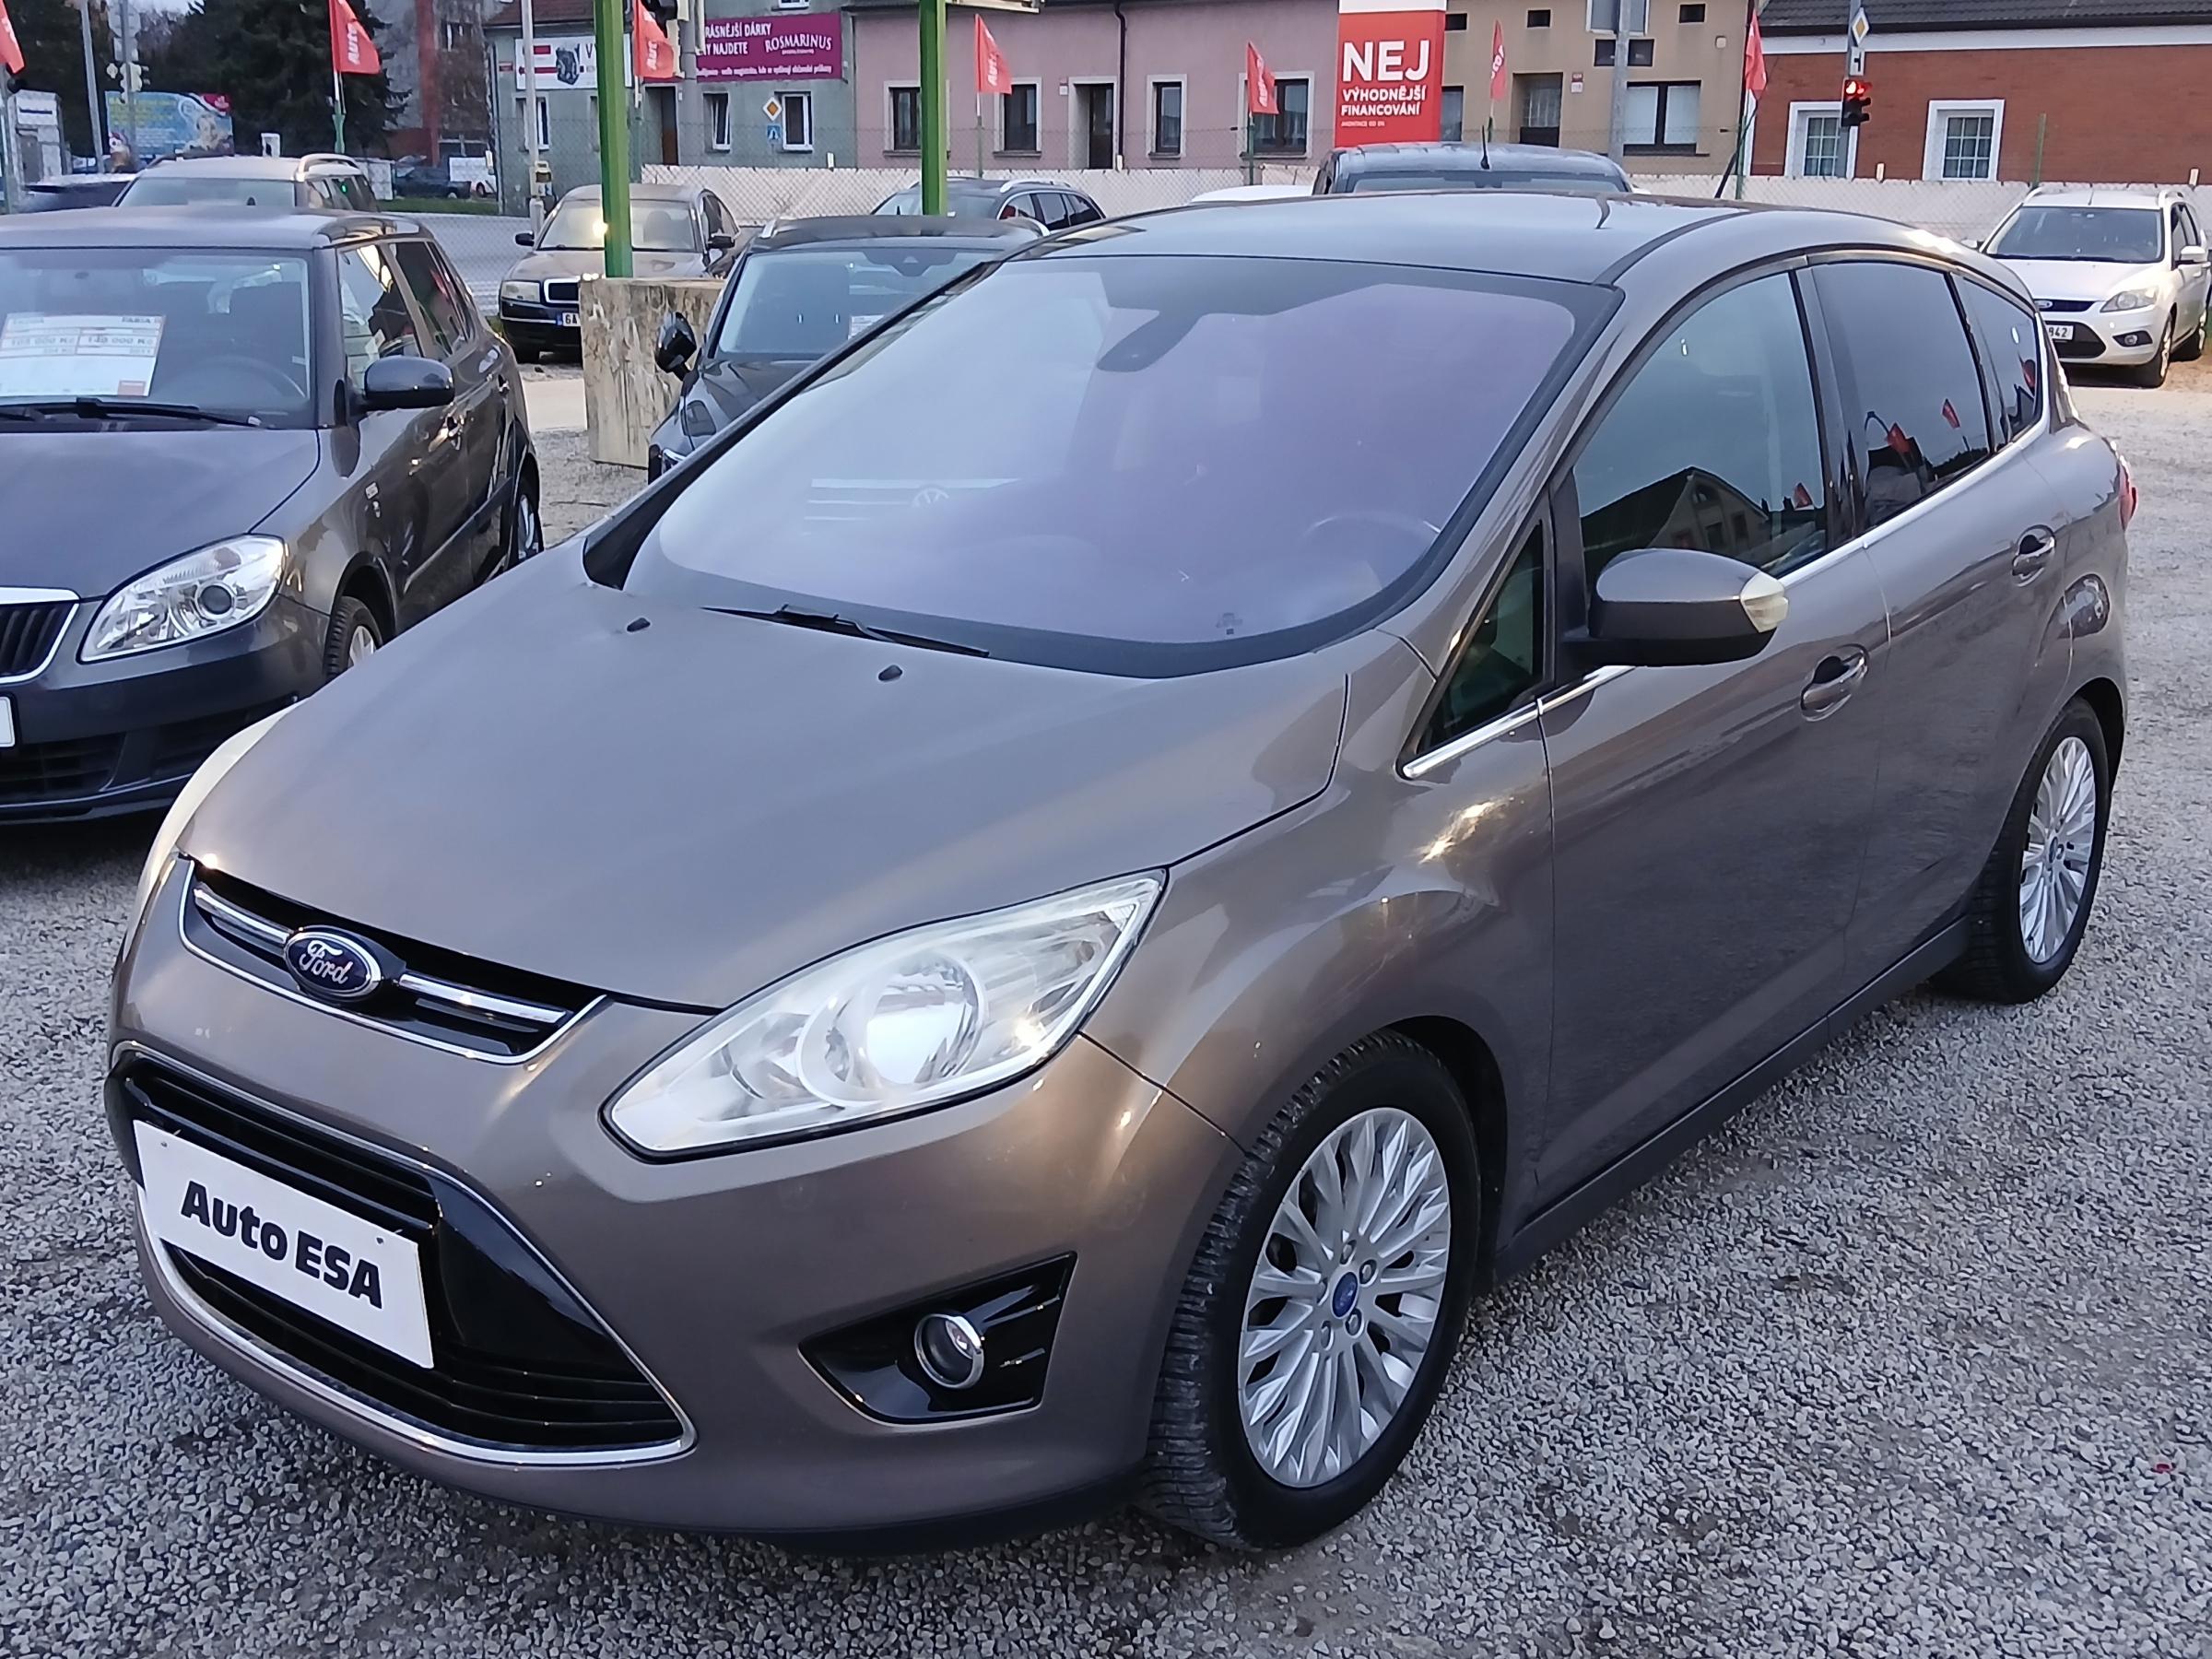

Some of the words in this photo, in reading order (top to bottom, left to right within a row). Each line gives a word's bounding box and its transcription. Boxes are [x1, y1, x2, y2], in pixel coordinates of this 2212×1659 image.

[705, 22, 742, 38] RÁSNĚJŠÍ
[712, 41, 748, 55] NAJDETE
[765, 33, 832, 53] ROSMARINUS
[1342, 40, 1430, 82] NEJ
[1342, 85, 1427, 101] VÝHODNĚJŠÍ
[1341, 101, 1420, 116] FINANCOVÁNÍ
[2048, 326, 2068, 338] 942
[299, 939, 354, 985] Ford
[181, 1180, 288, 1261] Auto
[295, 1230, 382, 1310] ESA
